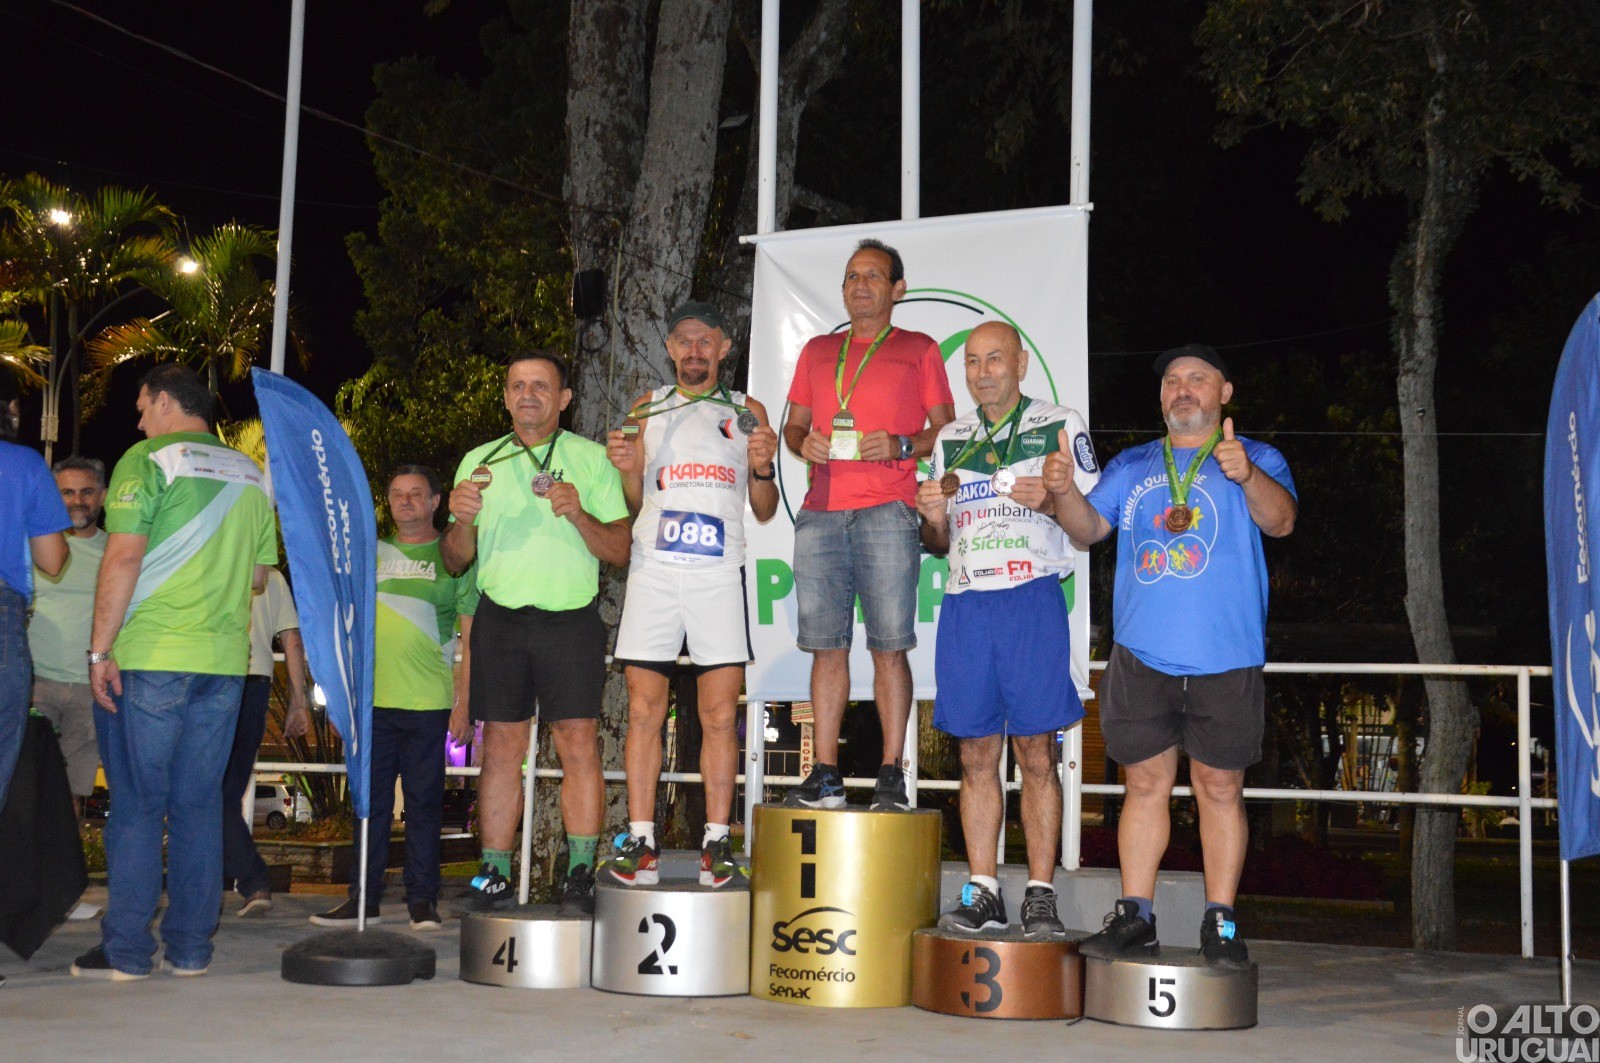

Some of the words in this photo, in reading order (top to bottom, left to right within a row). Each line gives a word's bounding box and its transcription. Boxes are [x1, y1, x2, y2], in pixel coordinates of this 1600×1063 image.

[669, 463, 736, 484] KAPASS
[1122, 484, 1144, 531] FAMILIA
[1143, 473, 1169, 487] QUE
[663, 520, 718, 547] 088
[970, 535, 1030, 552] Sicredi
[792, 819, 816, 898] 1
[486, 881, 506, 894] FILA
[492, 936, 518, 973] 4
[638, 913, 678, 975] 2
[771, 920, 857, 956] Sesc
[769, 963, 856, 983] Fecomércio
[769, 982, 811, 1000] Senac
[961, 946, 1003, 1013] 3
[1147, 977, 1177, 1018] 5
